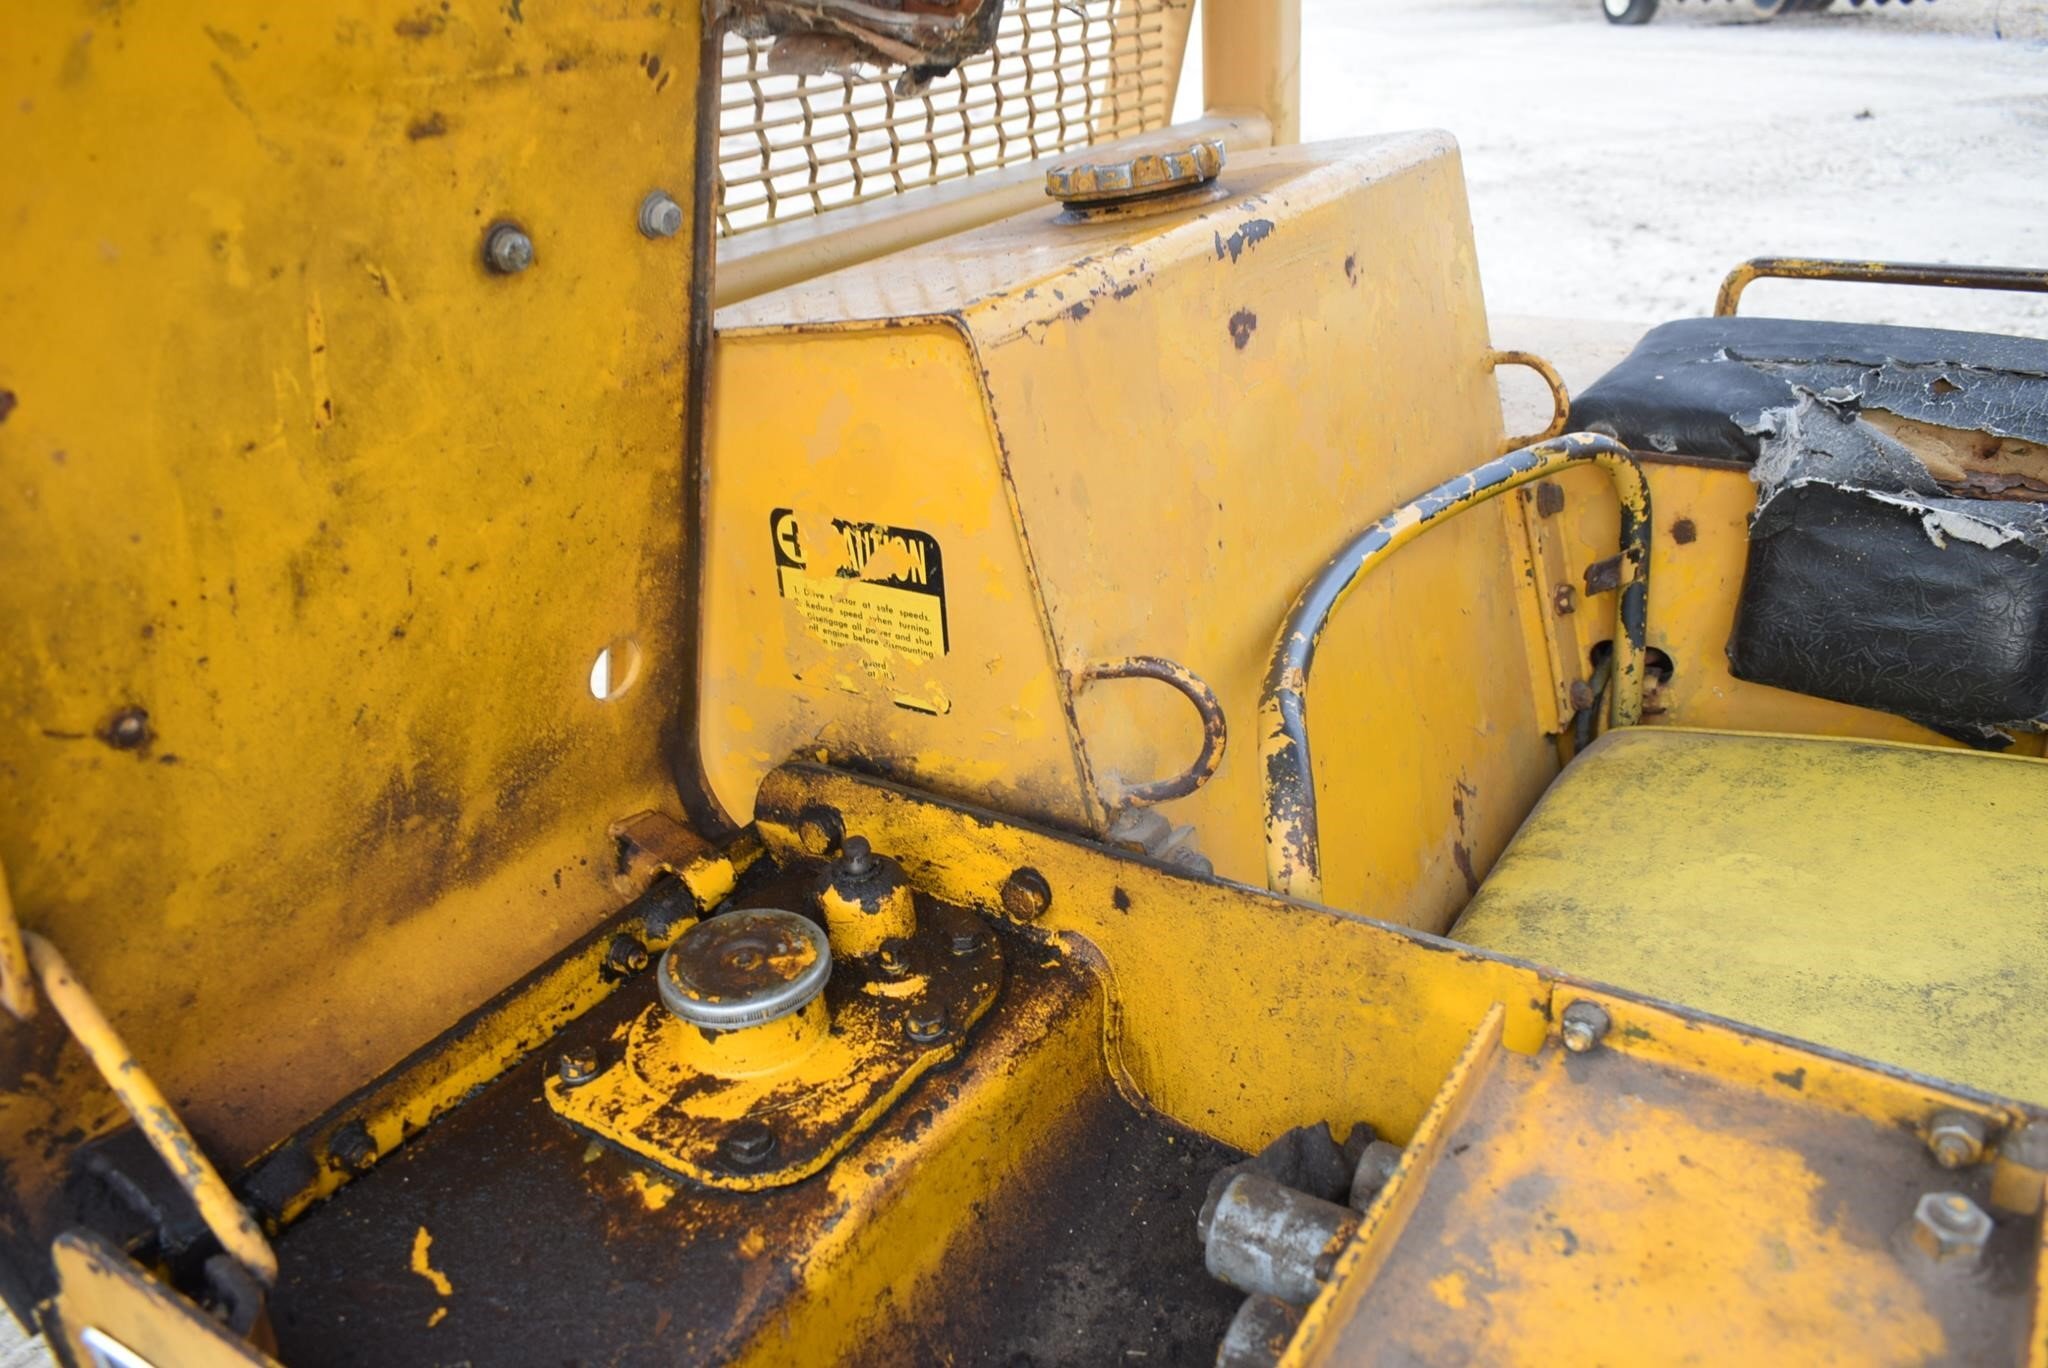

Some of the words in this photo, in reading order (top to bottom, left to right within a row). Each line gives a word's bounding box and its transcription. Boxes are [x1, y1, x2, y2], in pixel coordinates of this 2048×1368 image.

[839, 610, 864, 620] speed
[877, 604, 894, 614] safe
[822, 628, 850, 639] engine
[852, 632, 880, 646] before
[851, 622, 863, 631] all
[895, 632, 911, 642] and
[915, 636, 934, 647] shut
